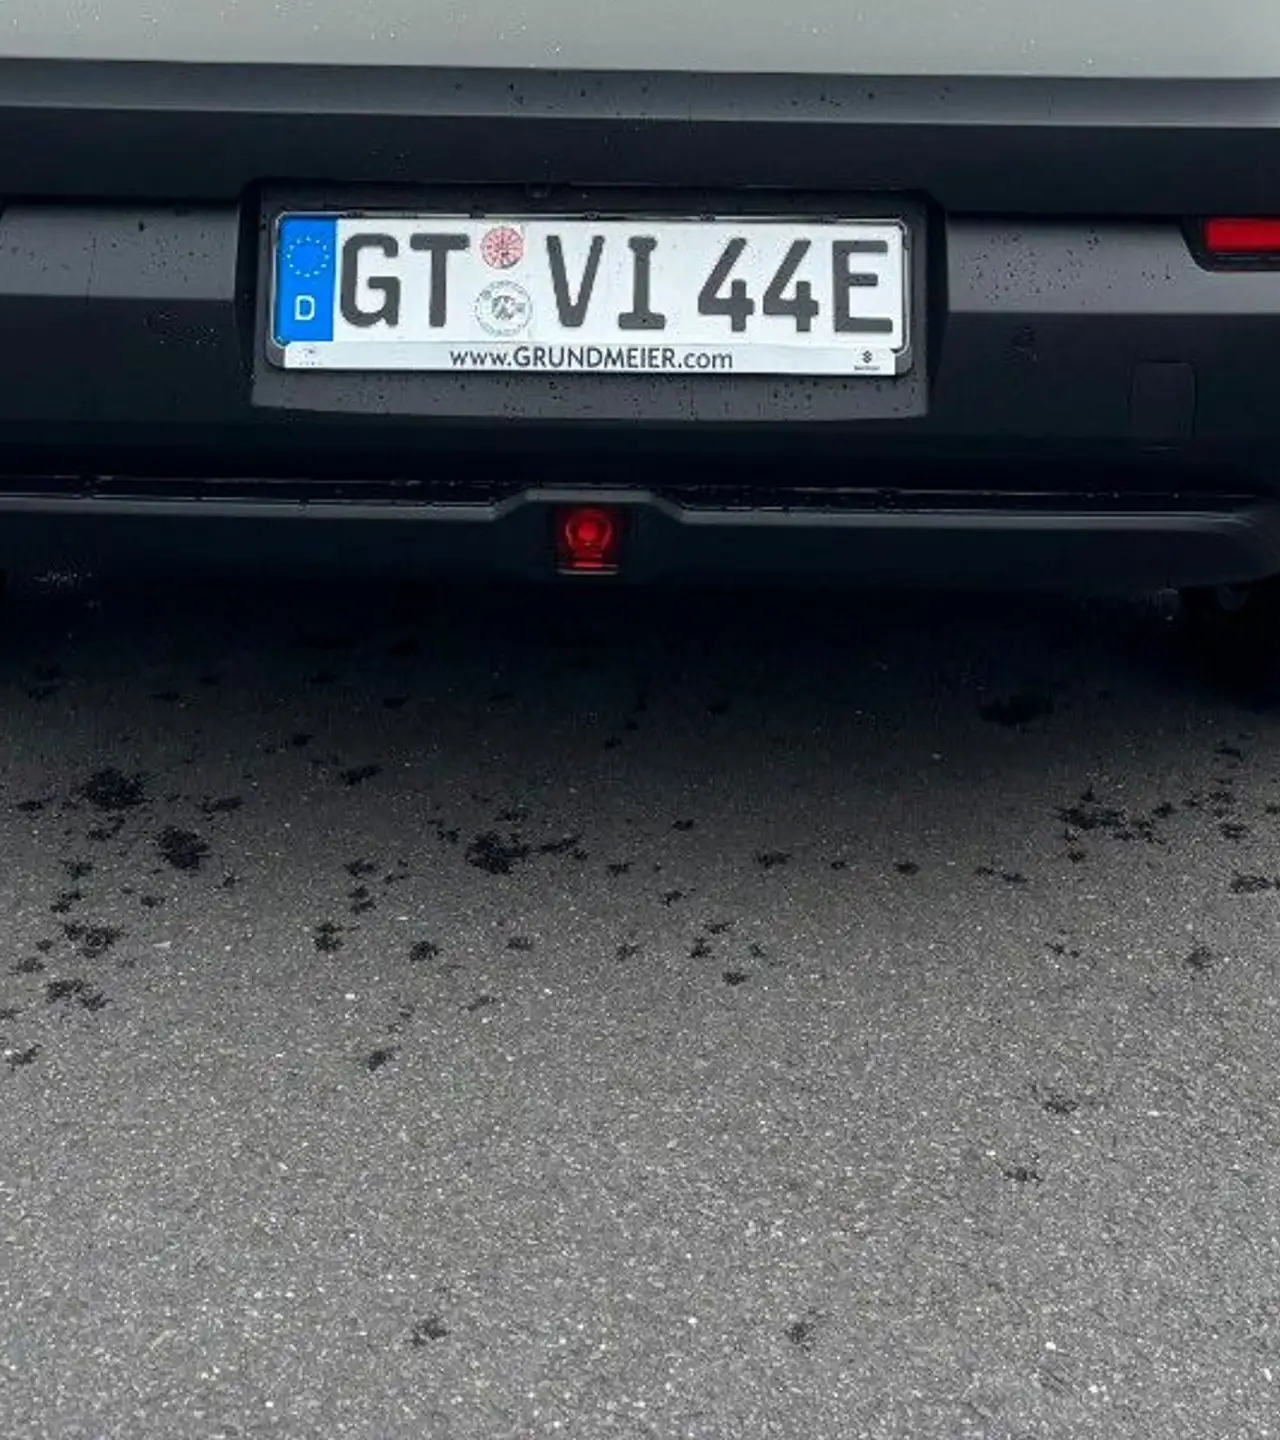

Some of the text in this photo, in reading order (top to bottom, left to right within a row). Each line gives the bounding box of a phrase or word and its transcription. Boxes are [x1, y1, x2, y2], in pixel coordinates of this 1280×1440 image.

[340, 233, 470, 329] GT
[546, 234, 666, 330] VI
[696, 236, 894, 333] 44E
[294, 294, 315, 321] D
[449, 345, 734, 370] www.GRUNDMEIER.com
